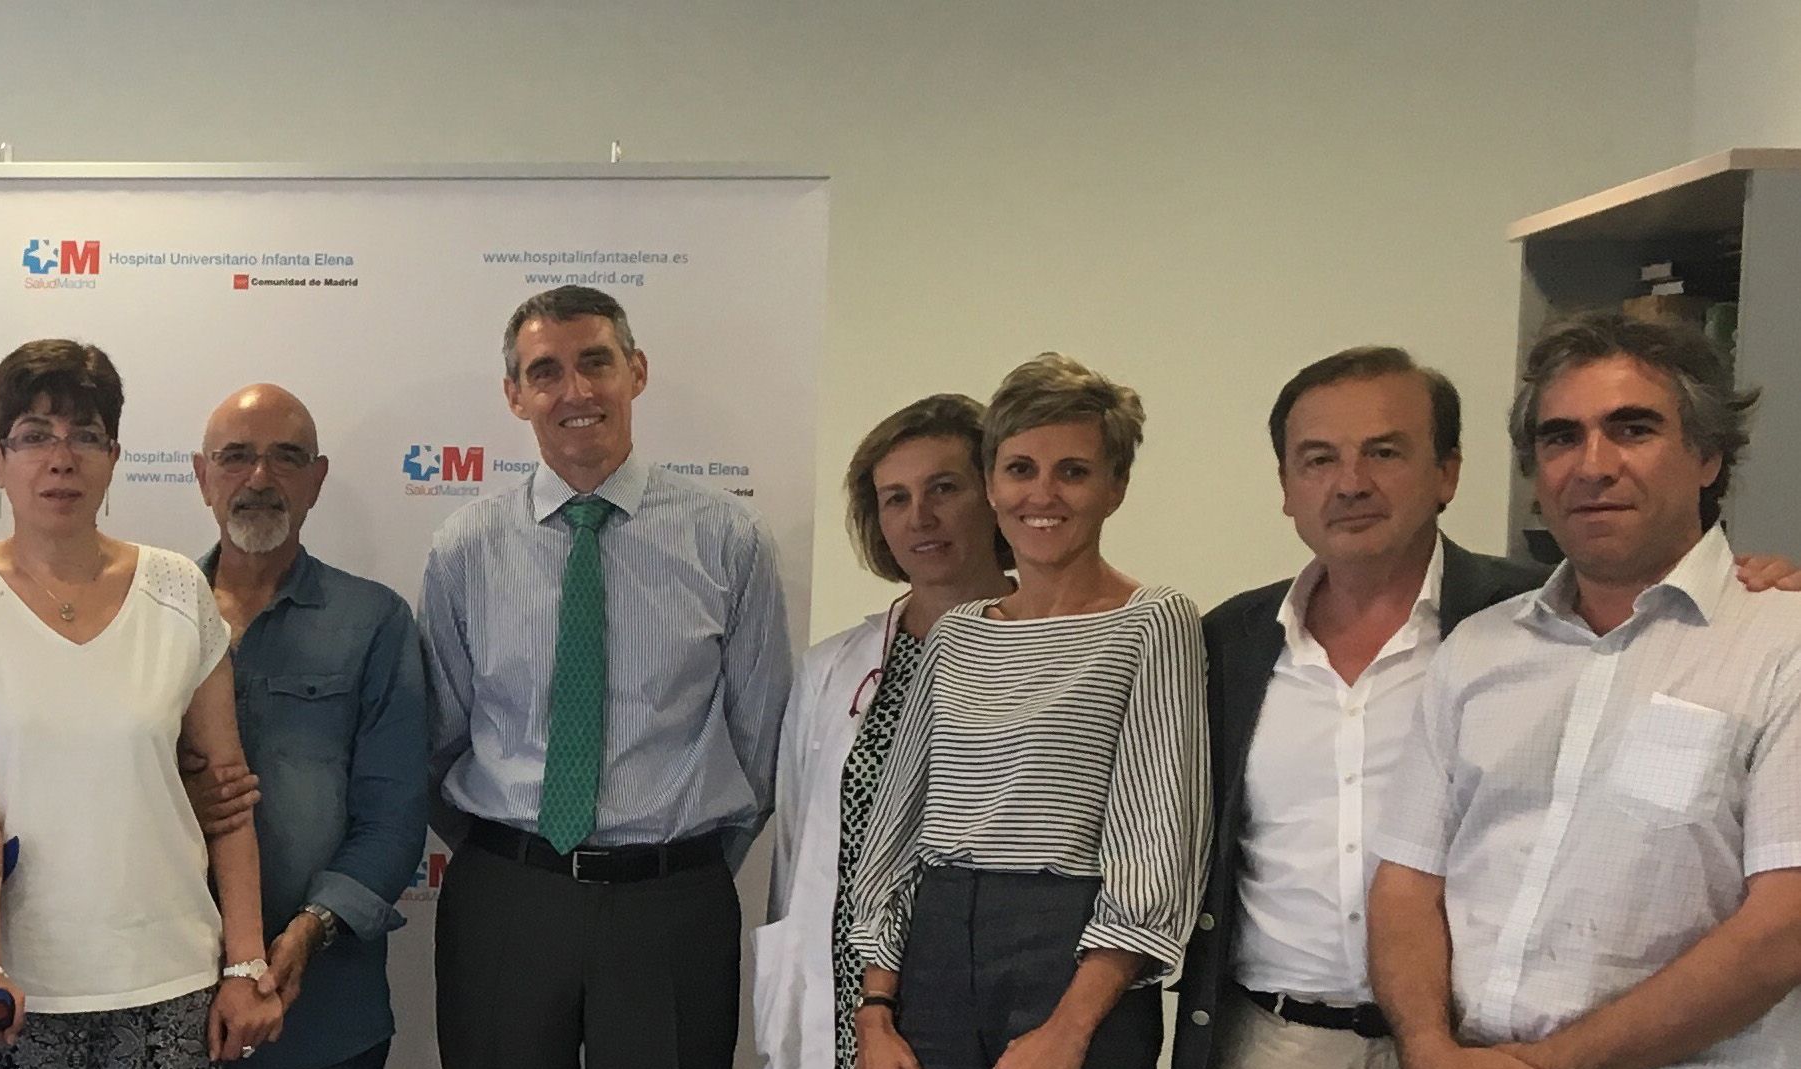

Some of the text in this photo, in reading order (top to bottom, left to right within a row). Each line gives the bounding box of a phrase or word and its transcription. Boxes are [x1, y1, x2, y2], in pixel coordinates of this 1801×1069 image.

[109, 252, 354, 267] Hospital Universitario Infanta Elena
[483, 249, 689, 266] www.hospitalinfantaelena.es
[24, 277, 96, 290] SaludMadrid
[251, 277, 358, 287] Comunidad de Madrid
[525, 270, 644, 287] www.madrid.org
[708, 463, 749, 476] Elena
[405, 484, 480, 497] SaludMadrid
